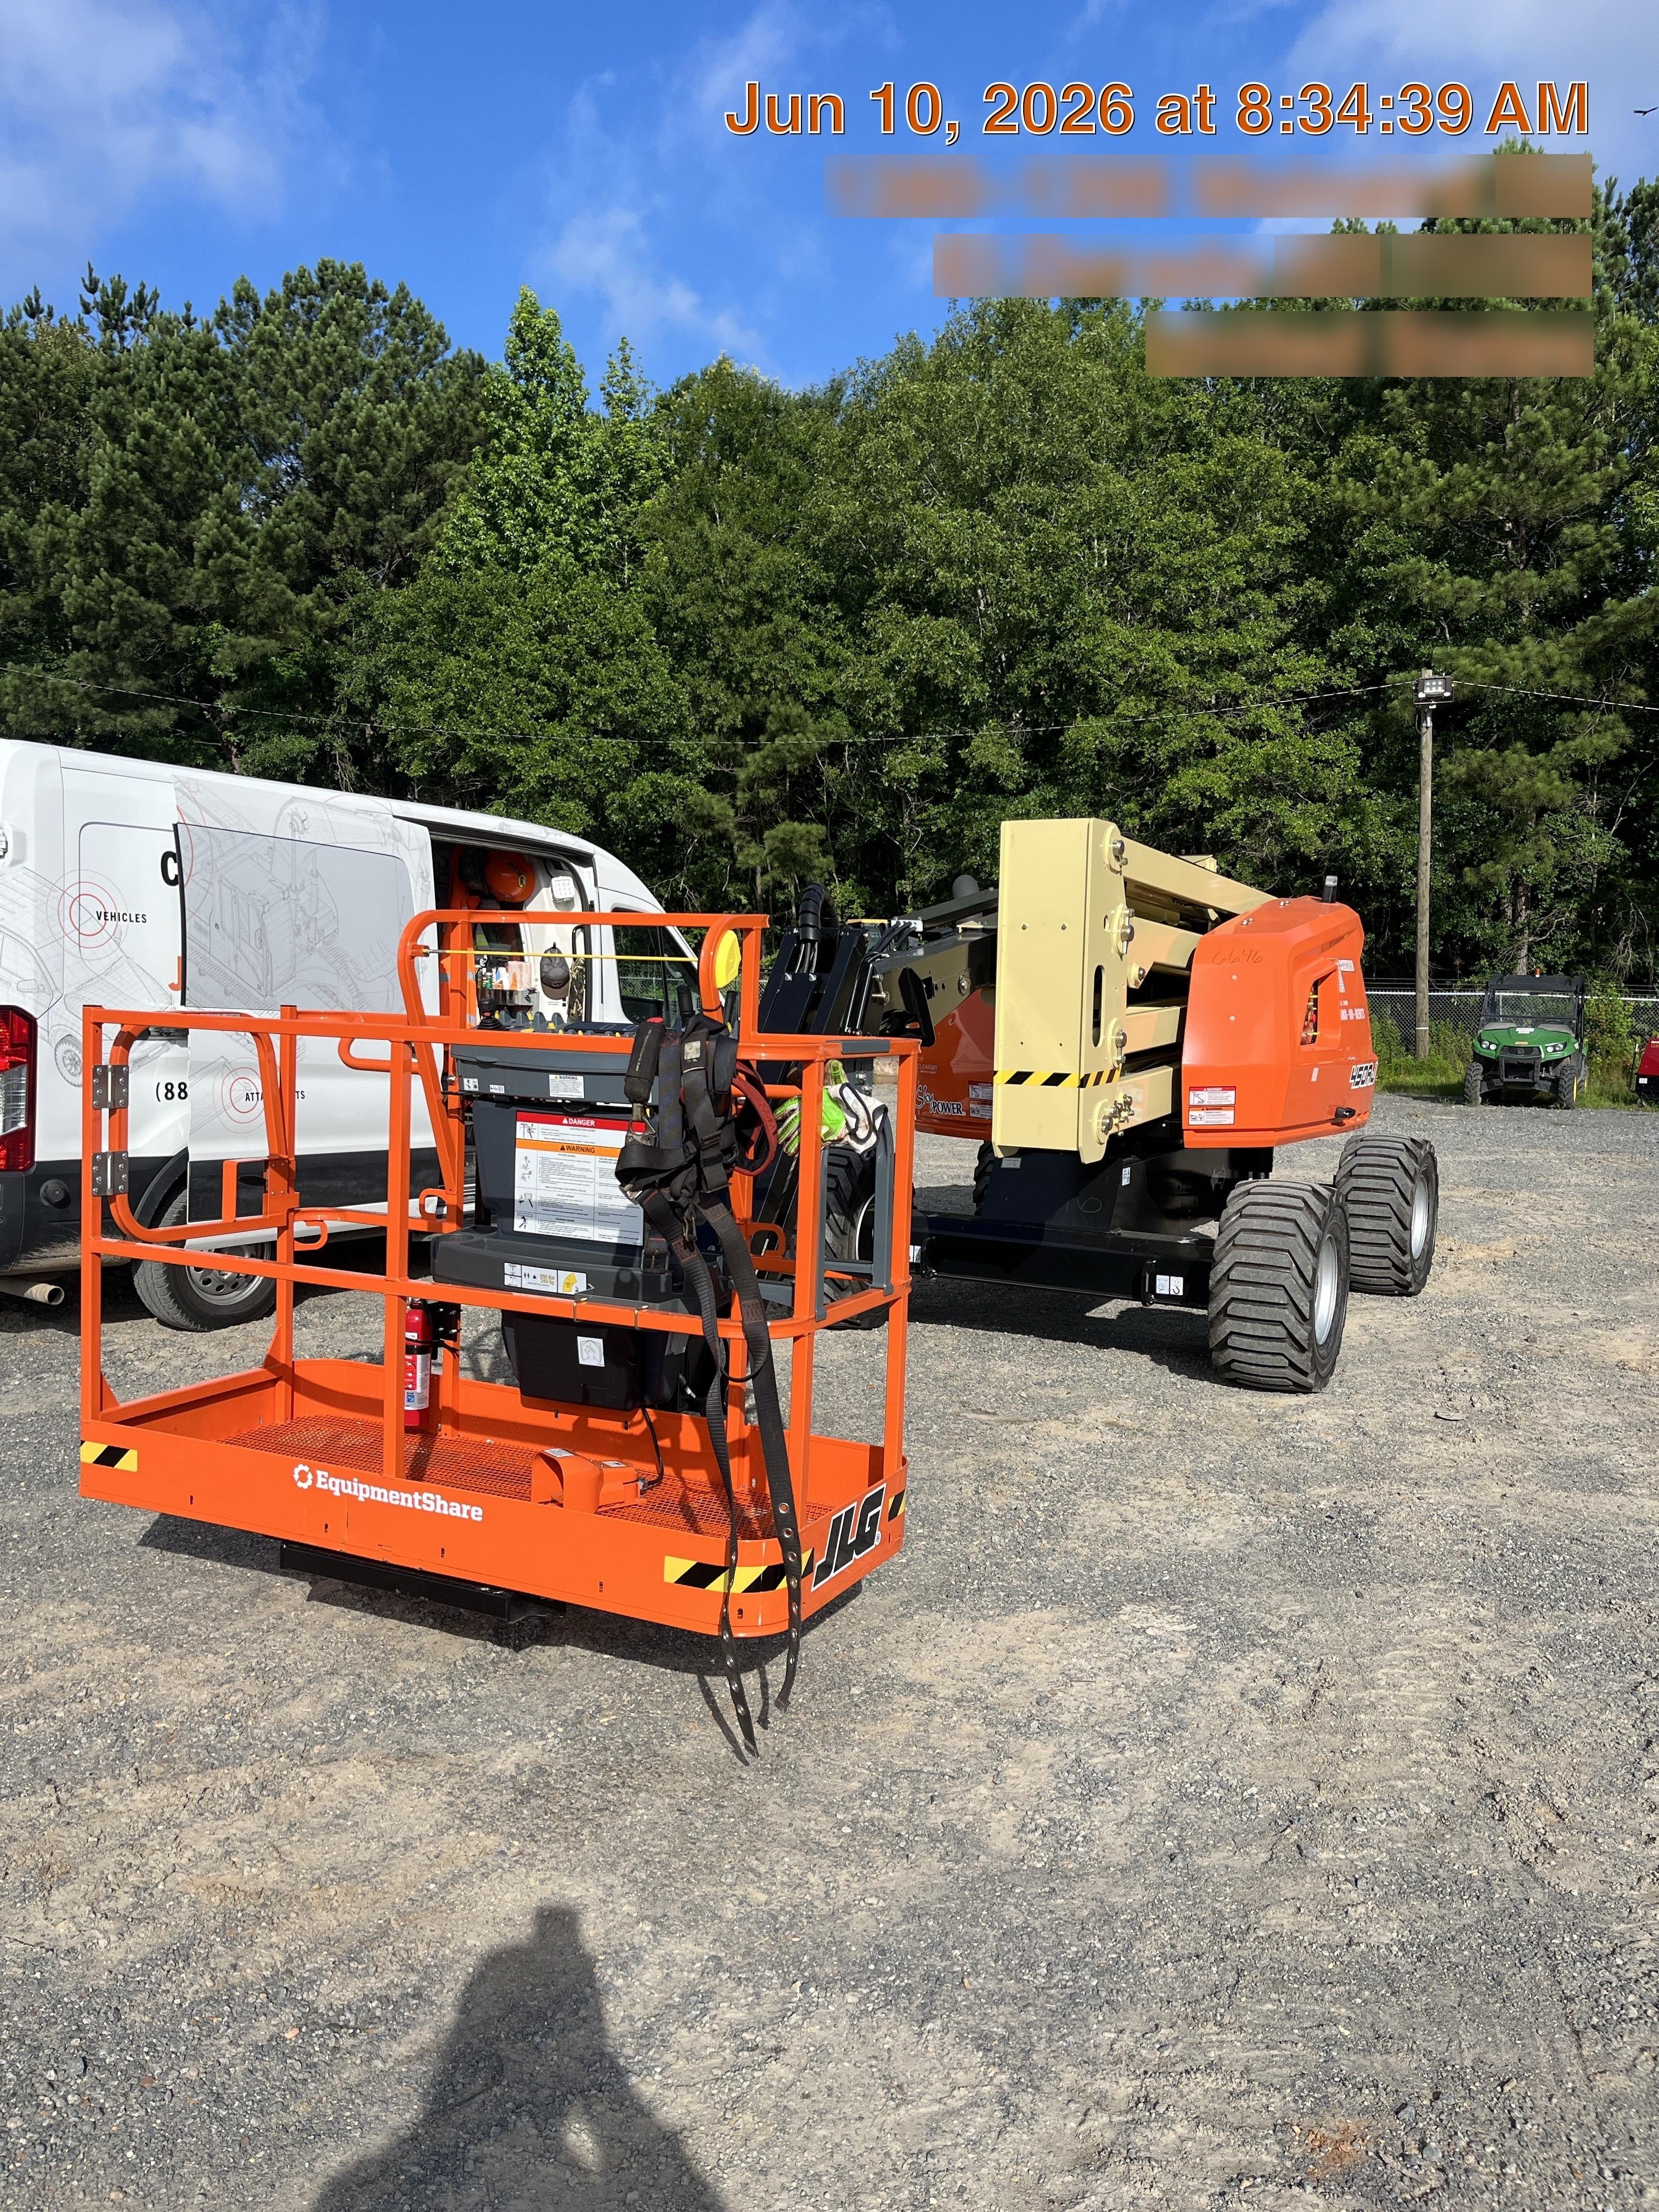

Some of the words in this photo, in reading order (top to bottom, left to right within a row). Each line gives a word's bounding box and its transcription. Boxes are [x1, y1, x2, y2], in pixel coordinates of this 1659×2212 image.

[96, 911, 147, 923] VEHICLES
[1212, 950, 1263, 966] 6646
[156, 1082, 188, 1102] (88
[568, 1118, 595, 1127] DANGER
[566, 1145, 595, 1153] WARNING
[316, 1470, 483, 1521] EquipmentShare
[811, 1482, 887, 1593] JLG
